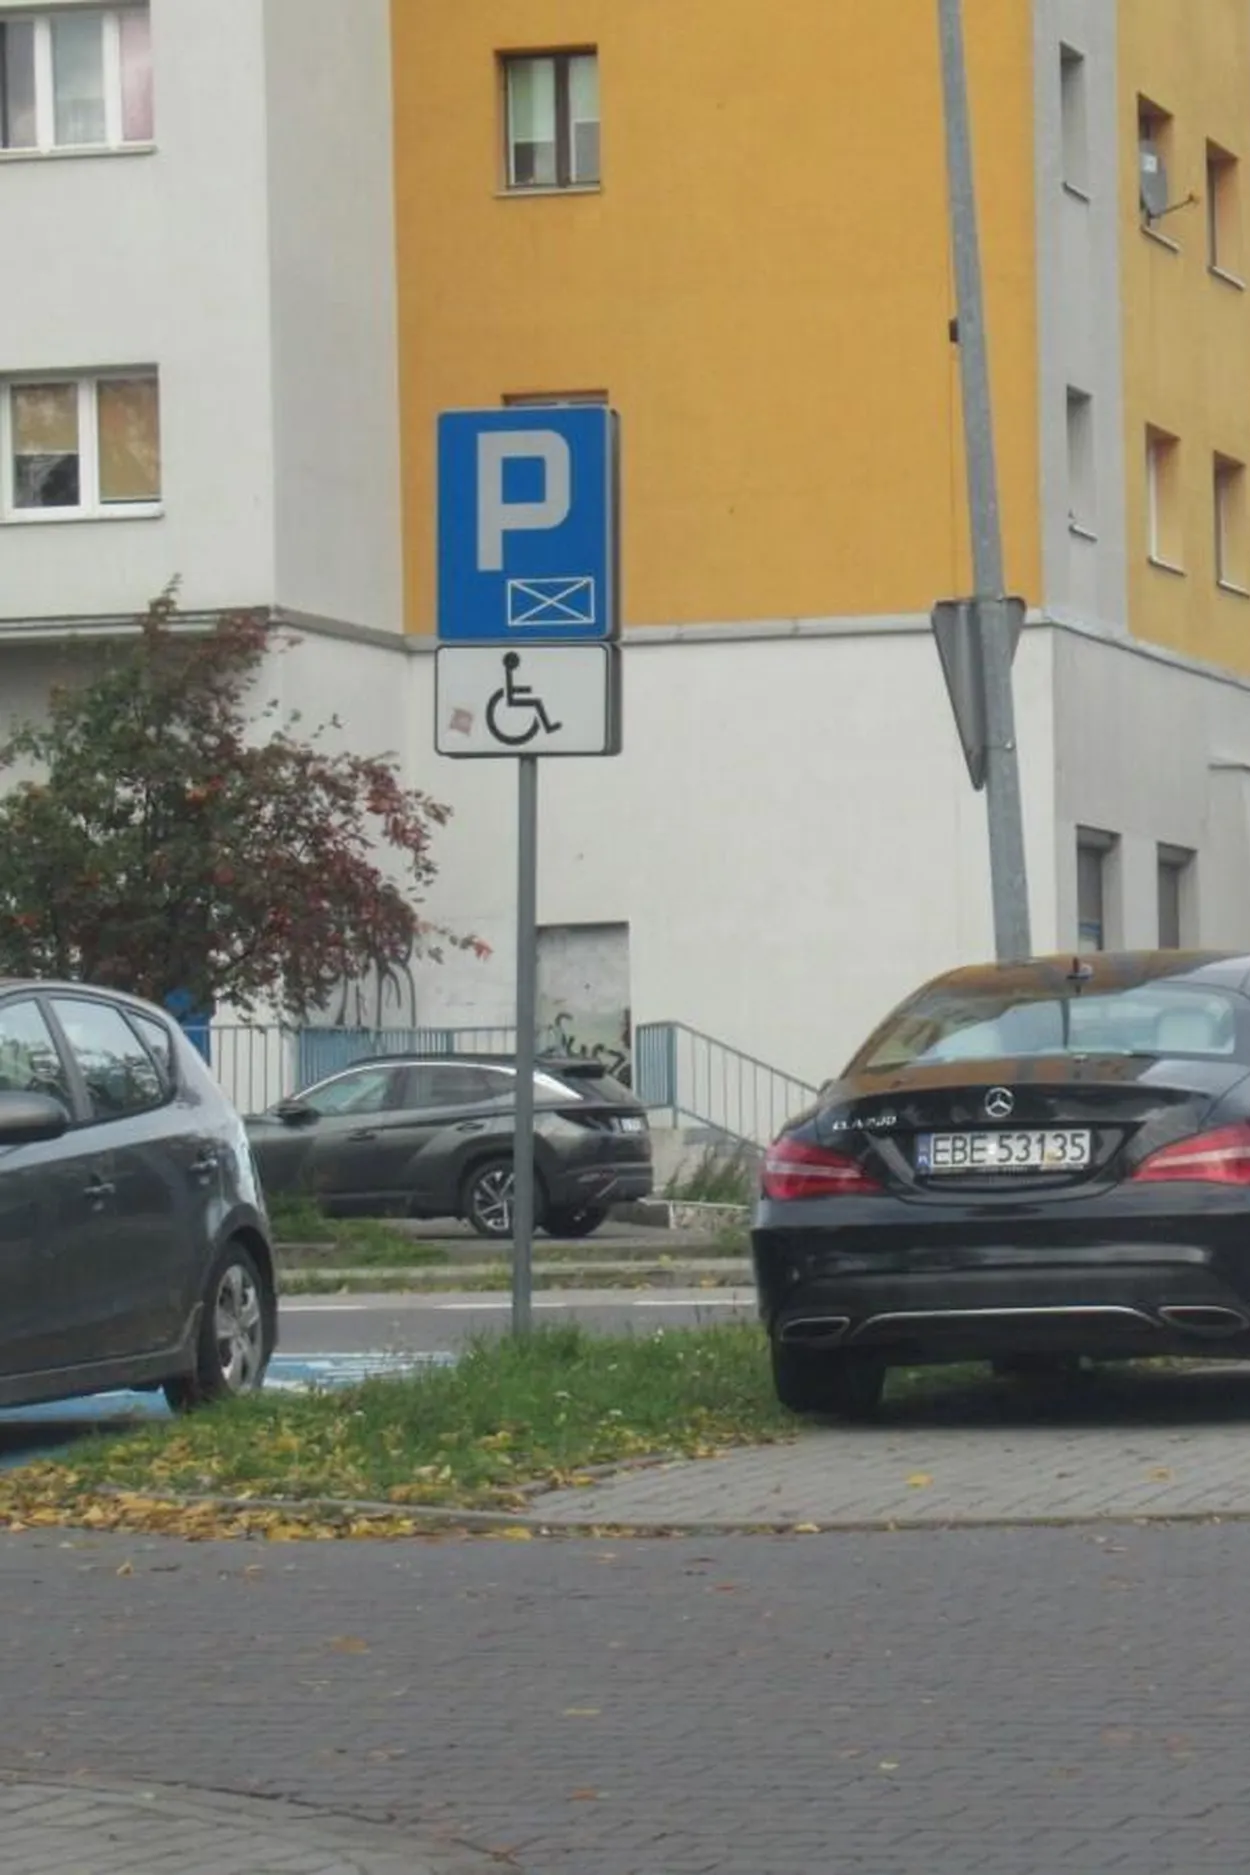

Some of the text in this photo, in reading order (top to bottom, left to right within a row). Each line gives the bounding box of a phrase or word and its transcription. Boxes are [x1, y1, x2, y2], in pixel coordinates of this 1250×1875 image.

[477, 429, 570, 571] P
[933, 1132, 1086, 1165] EBE 53135
